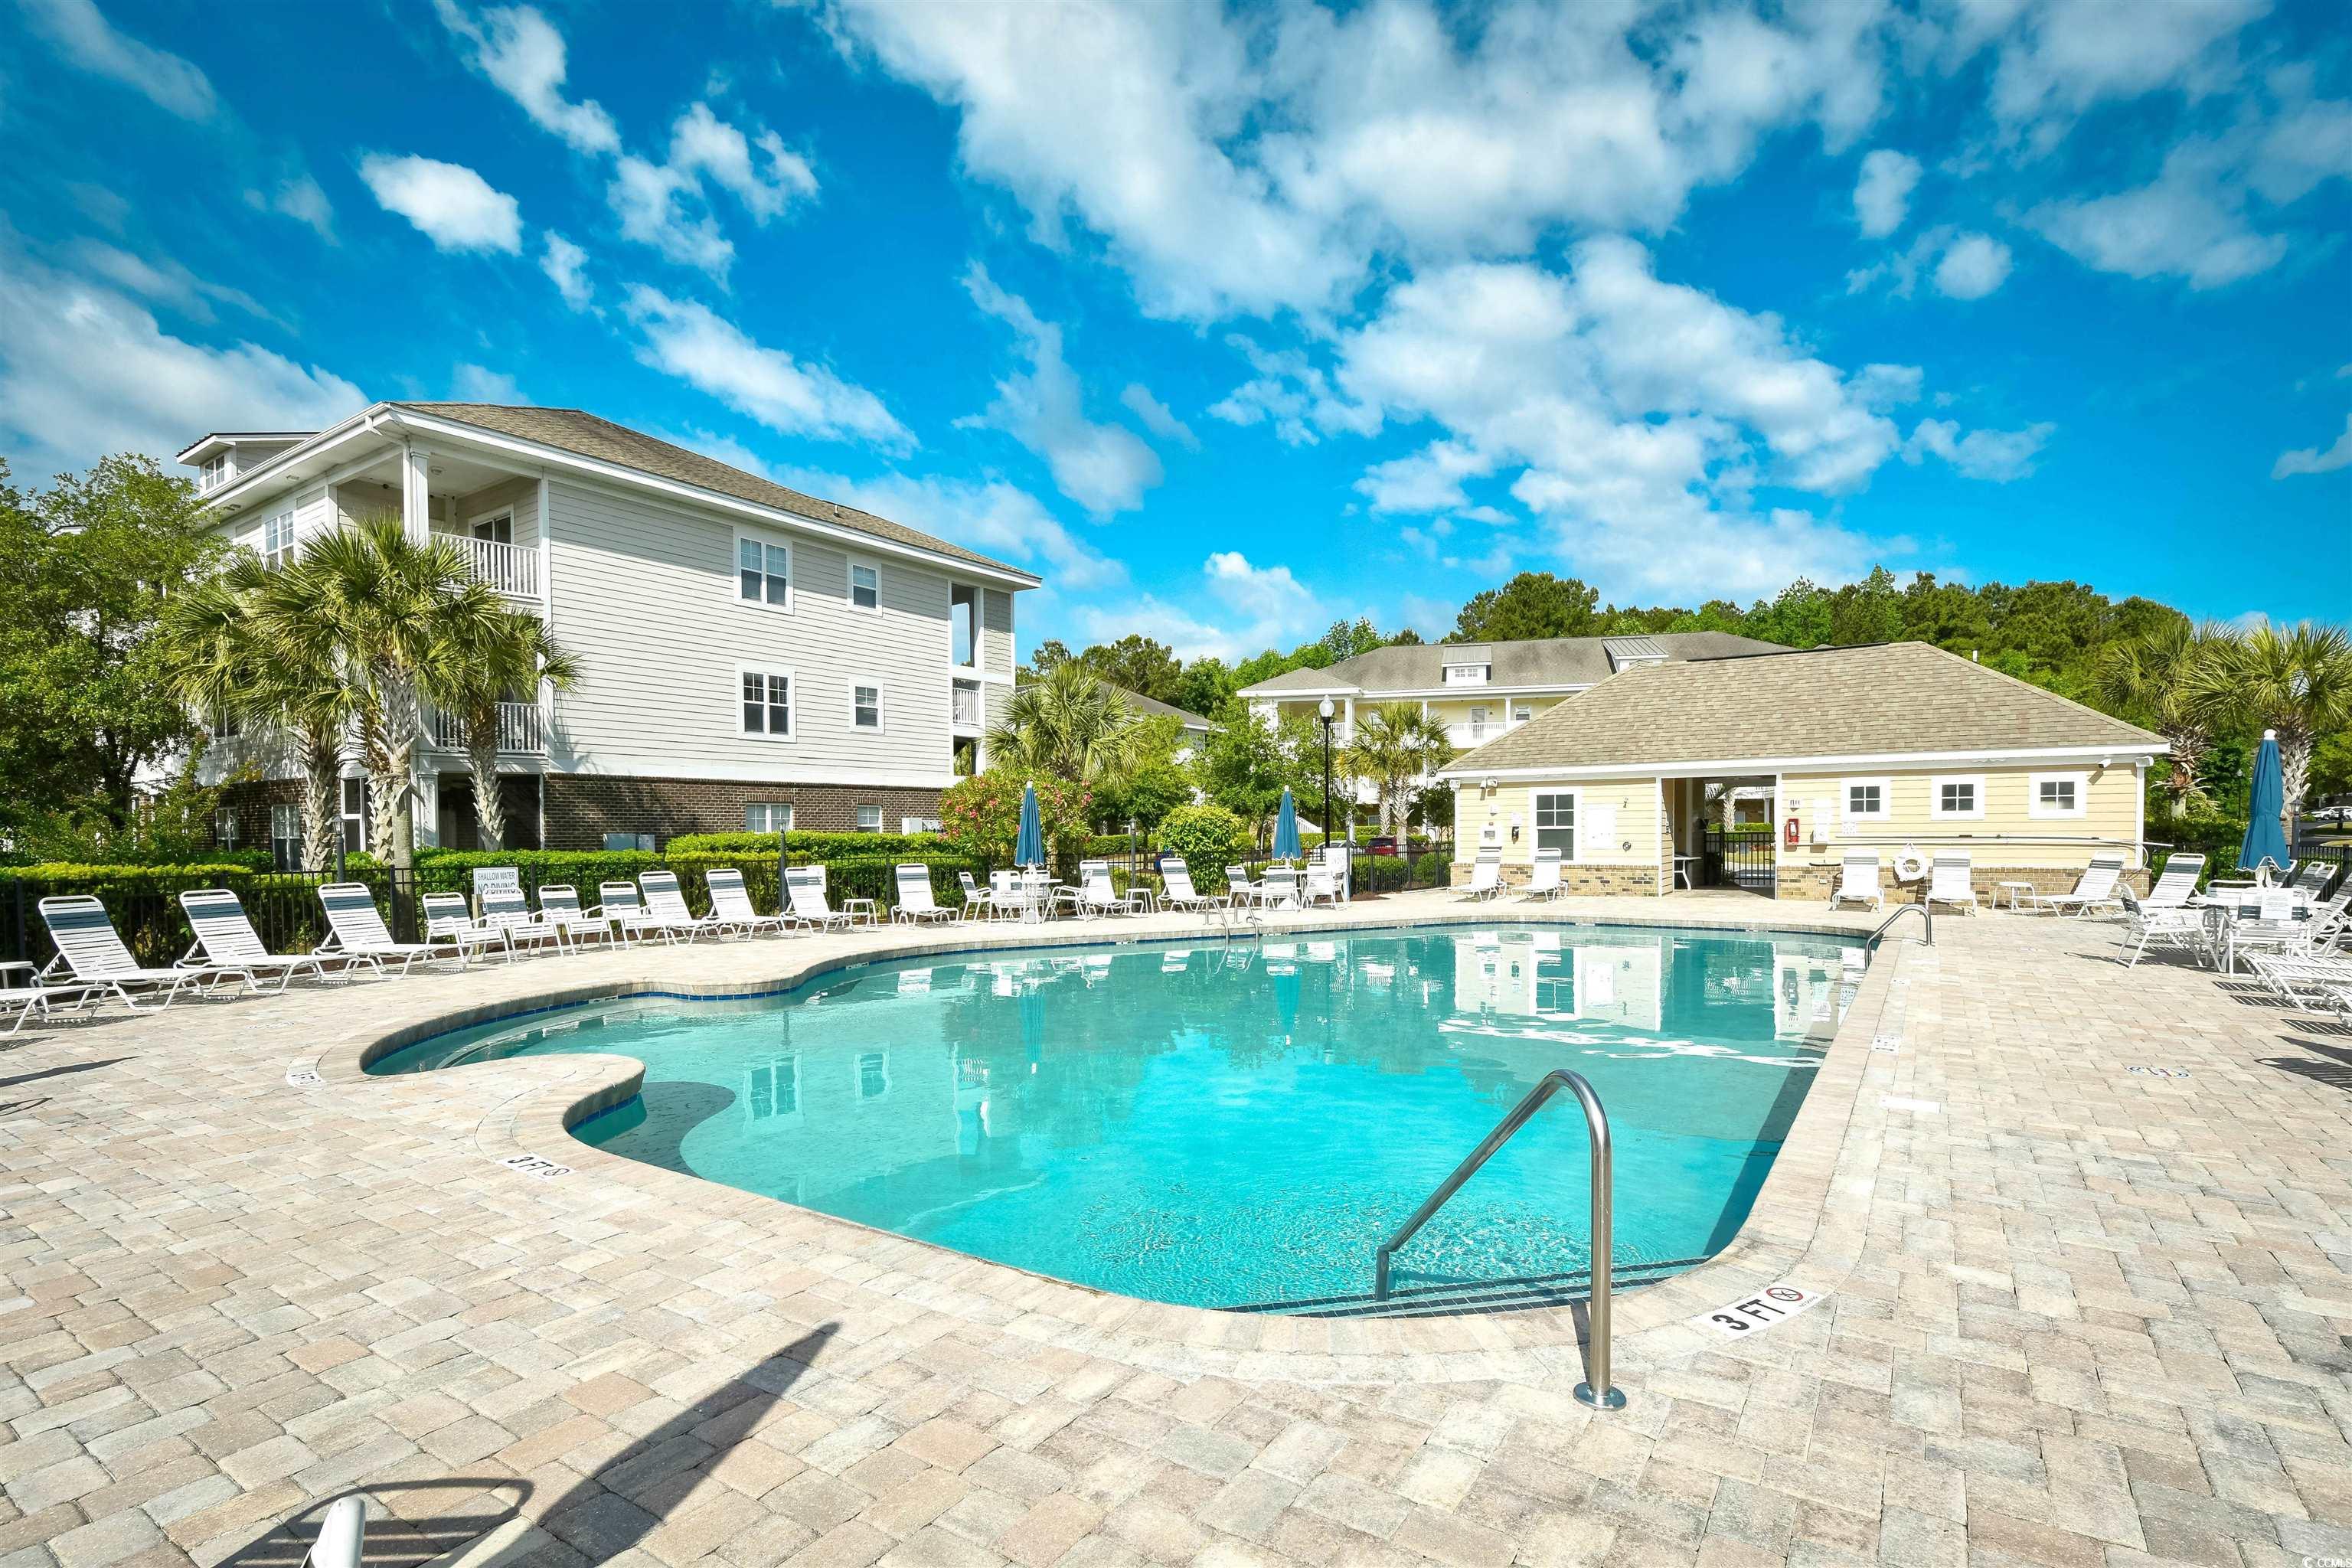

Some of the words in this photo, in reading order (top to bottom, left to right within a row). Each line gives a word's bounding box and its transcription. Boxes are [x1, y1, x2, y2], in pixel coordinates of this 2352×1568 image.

[478, 872, 499, 880] SHALLOW
[499, 871, 515, 880] WATER
[518, 1161, 554, 1171] FT
[1711, 1314, 1750, 1331] 3
[1734, 1298, 1786, 1321] FT
